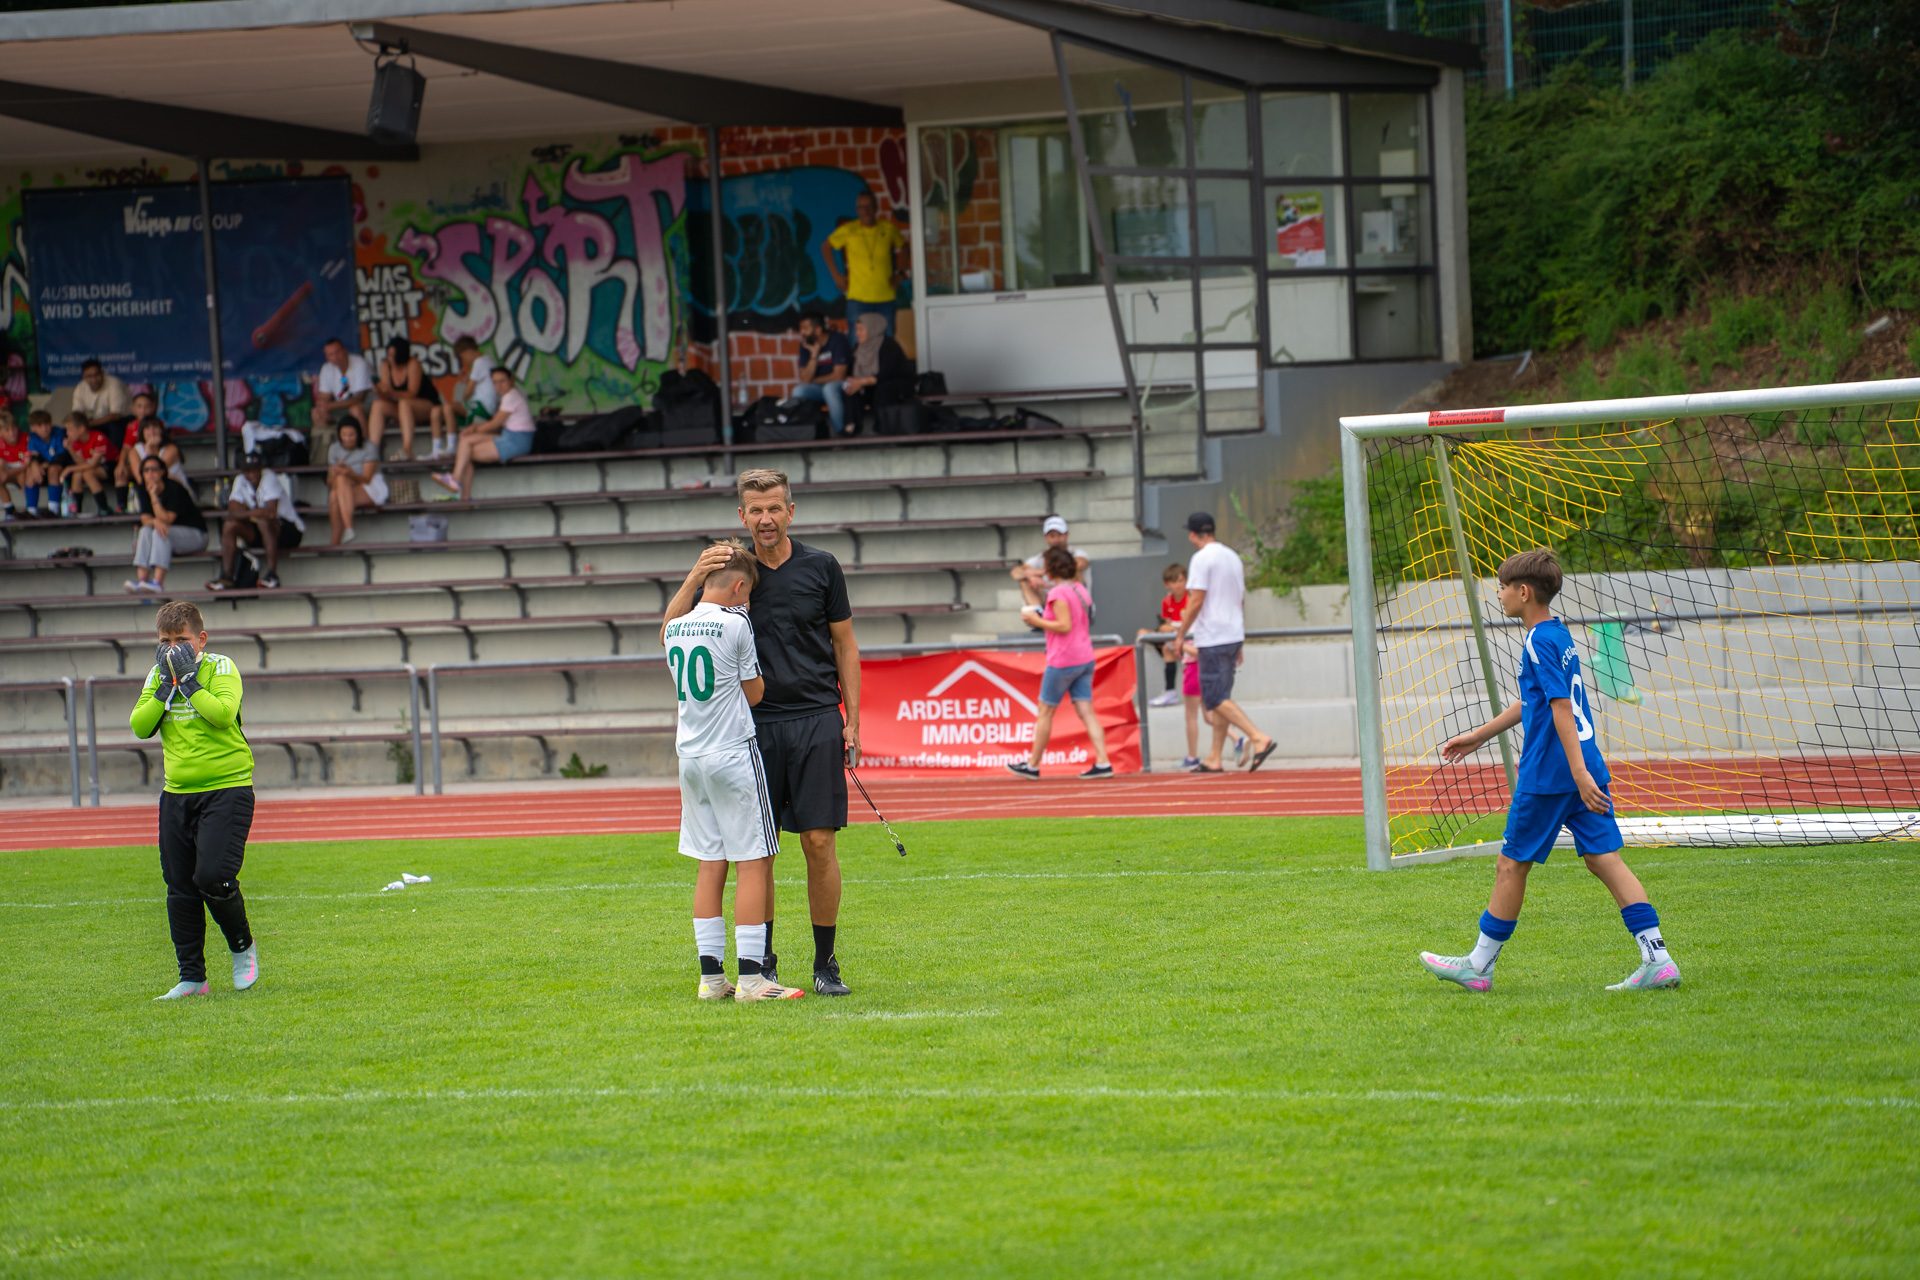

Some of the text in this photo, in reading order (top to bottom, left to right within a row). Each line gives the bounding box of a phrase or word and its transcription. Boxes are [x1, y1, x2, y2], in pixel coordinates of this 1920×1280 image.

[192, 213, 243, 231] GOUP
[356, 265, 412, 293] WAS
[41, 283, 132, 300] AUSBILDUNG
[42, 299, 172, 319] WIRD SICHERHEIT
[669, 645, 715, 701] 20
[896, 698, 1011, 721] ARDELEAN
[922, 722, 1036, 745] IMMOBILIE
